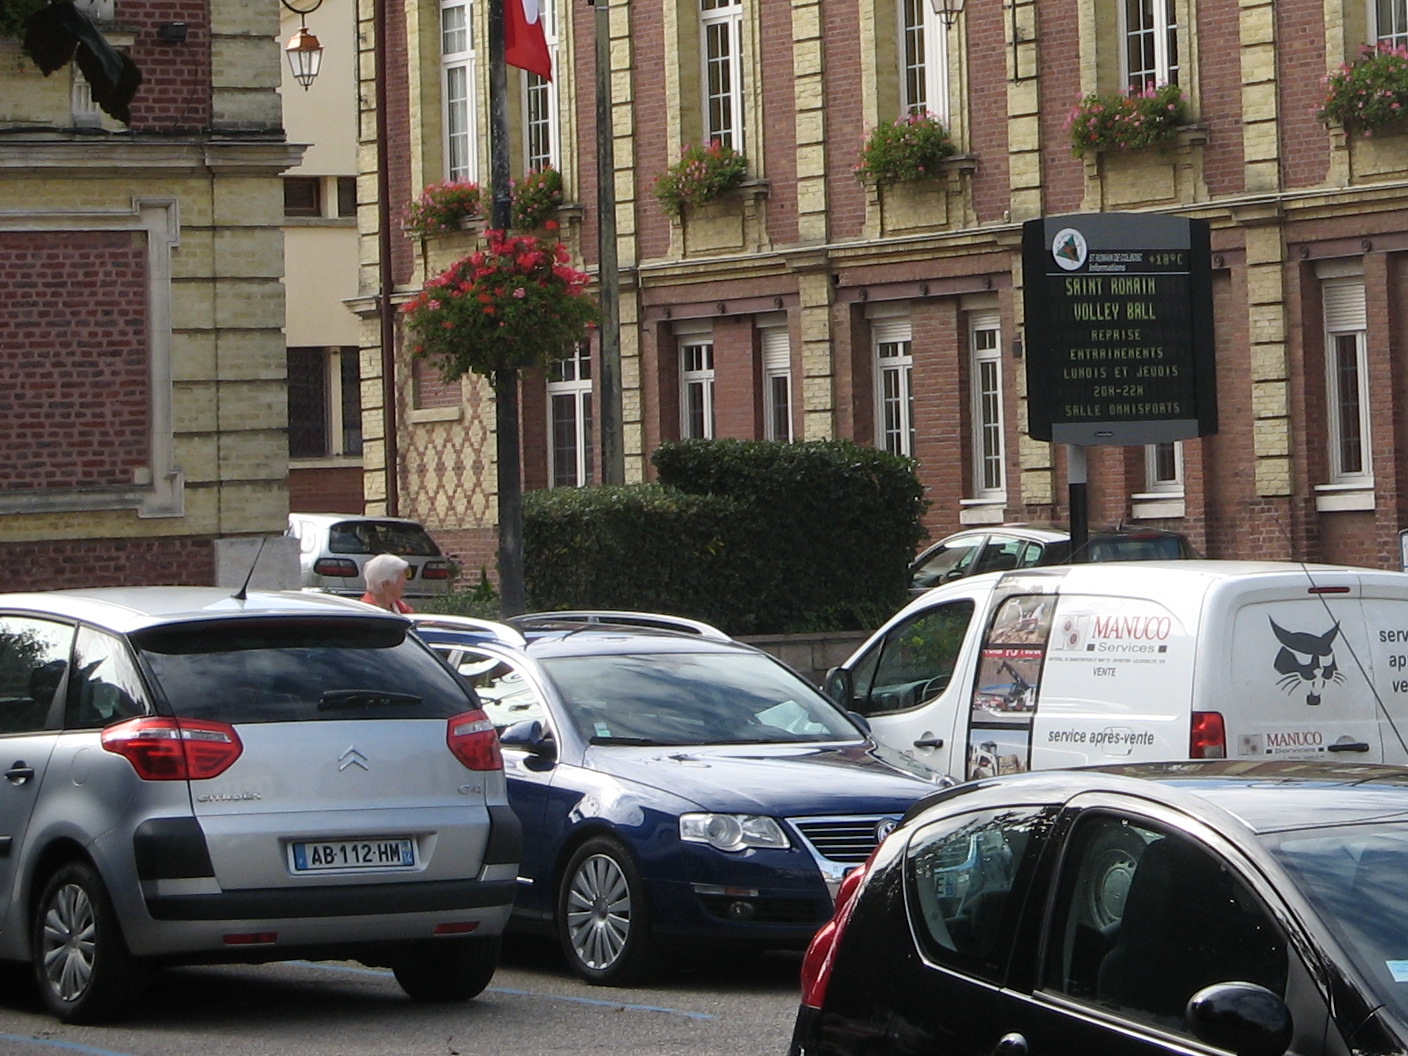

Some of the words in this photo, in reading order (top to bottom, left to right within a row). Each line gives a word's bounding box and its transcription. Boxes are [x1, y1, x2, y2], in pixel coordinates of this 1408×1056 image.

[1065, 278, 1103, 296] SAINT
[1110, 278, 1156, 295] ROMAIN
[1073, 302, 1120, 321] VOLLEY
[1126, 302, 1156, 320] BALL
[1091, 329, 1141, 341] REPRISE
[1063, 366, 1107, 380] LUNDIS
[1114, 365, 1128, 378] ET
[1136, 364, 1179, 378] JEUDIS
[1093, 385, 1144, 396] 20H-22H
[1065, 405, 1101, 417] SALLE
[1109, 402, 1180, 415] OMNISPORTS
[1091, 615, 1171, 641] MANUCO
[1097, 642, 1155, 654] Services
[1093, 667, 1117, 678] VENTE
[1048, 728, 1086, 744] service
[1088, 729, 1154, 748] après-vente
[1266, 731, 1323, 747] MANUCO
